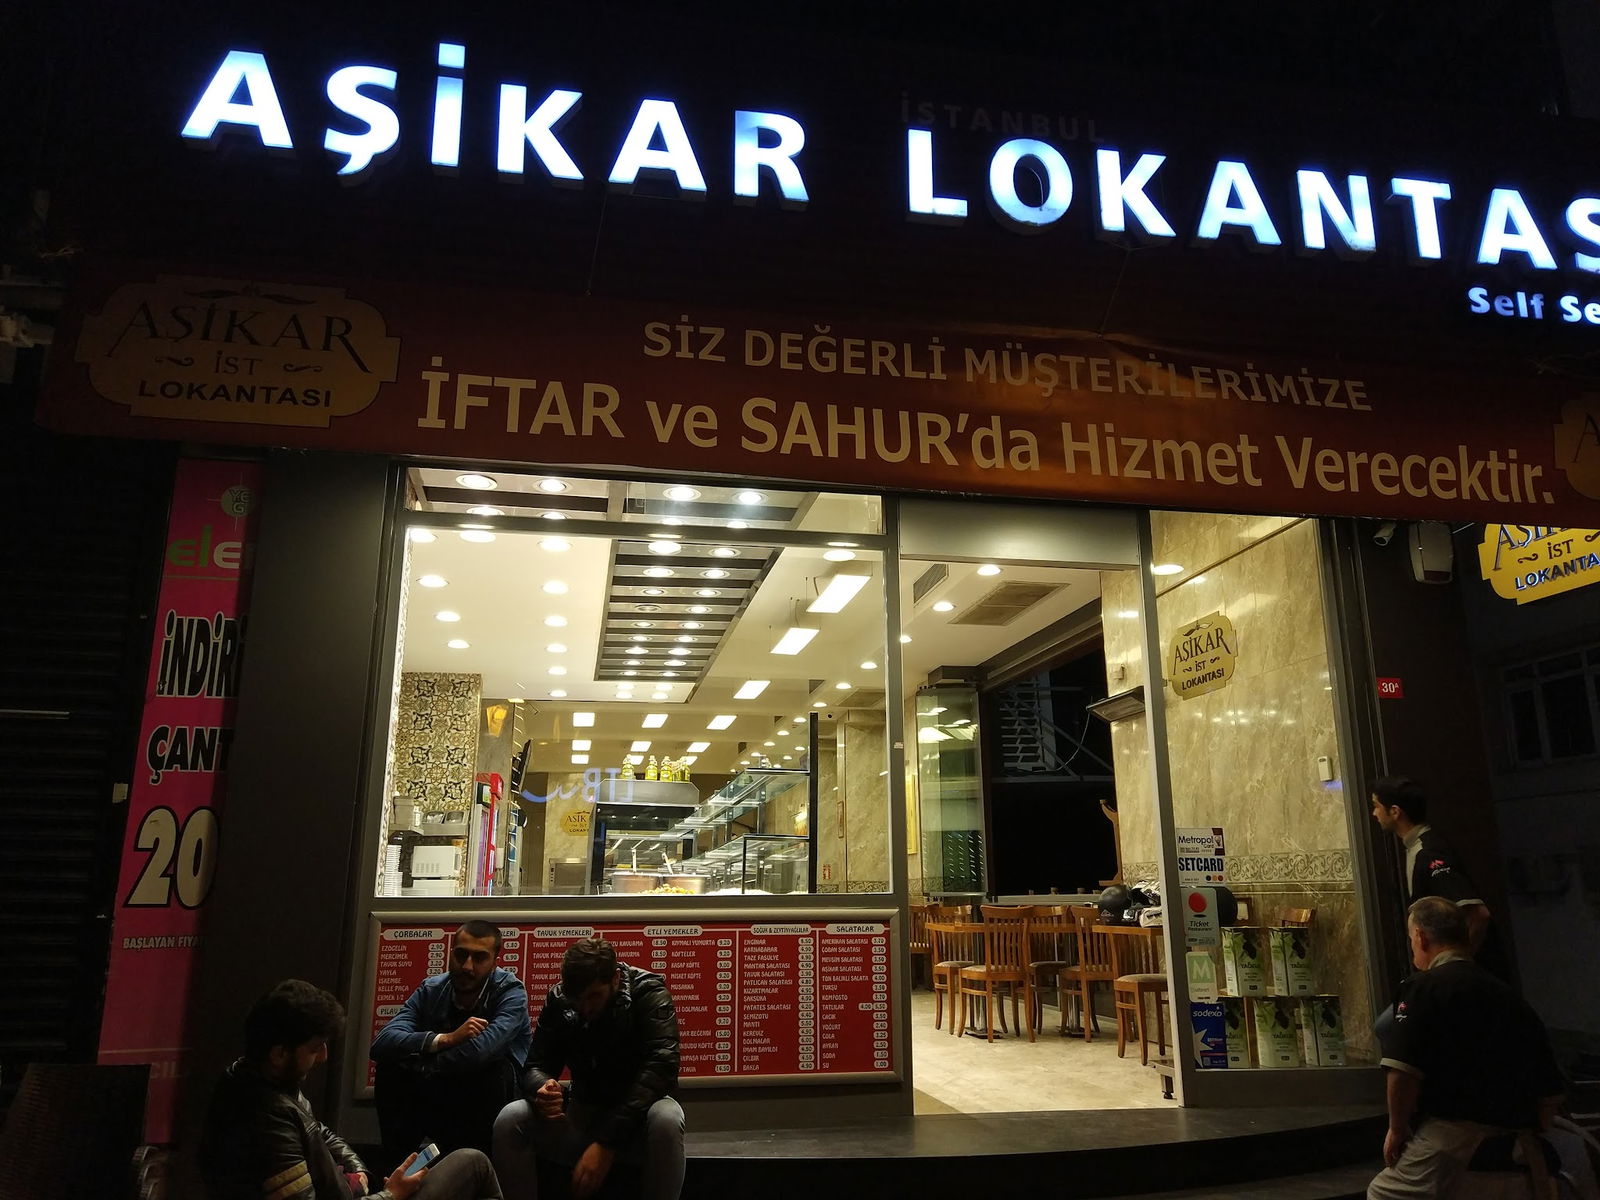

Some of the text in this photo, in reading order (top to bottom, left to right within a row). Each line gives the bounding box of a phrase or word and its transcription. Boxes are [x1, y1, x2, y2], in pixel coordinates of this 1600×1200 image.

[181, 43, 808, 202] AŞİKAR
[900, 90, 1105, 144] İSTANBUL
[1467, 286, 1545, 320] Self
[105, 300, 373, 375] AŞİKAR
[214, 350, 263, 375] İST
[643, 314, 1373, 411] SİZ DEĞERLİ MÜŞTERİLERİMİZE
[138, 380, 331, 408] LOKANTASI
[417, 355, 626, 438] İFTAR
[645, 401, 720, 448] ve
[1061, 421, 1262, 487] Hizmet
[1274, 434, 1556, 505] Verecektir.
[1547, 539, 1573, 560] İST
[1173, 628, 1232, 675] AŞİKAR
[1195, 660, 1207, 672] İST
[1182, 668, 1225, 690] LOKANTASI
[1178, 836, 1214, 846] Metropol
[123, 806, 221, 911] 20
[1178, 857, 1224, 872] SETCARD
[393, 930, 433, 939] ÇORBALAR
[836, 925, 875, 933] SALATALAR
[123, 936, 176, 951] BAŞLAYAN
[1192, 1009, 1223, 1018] sodexo
